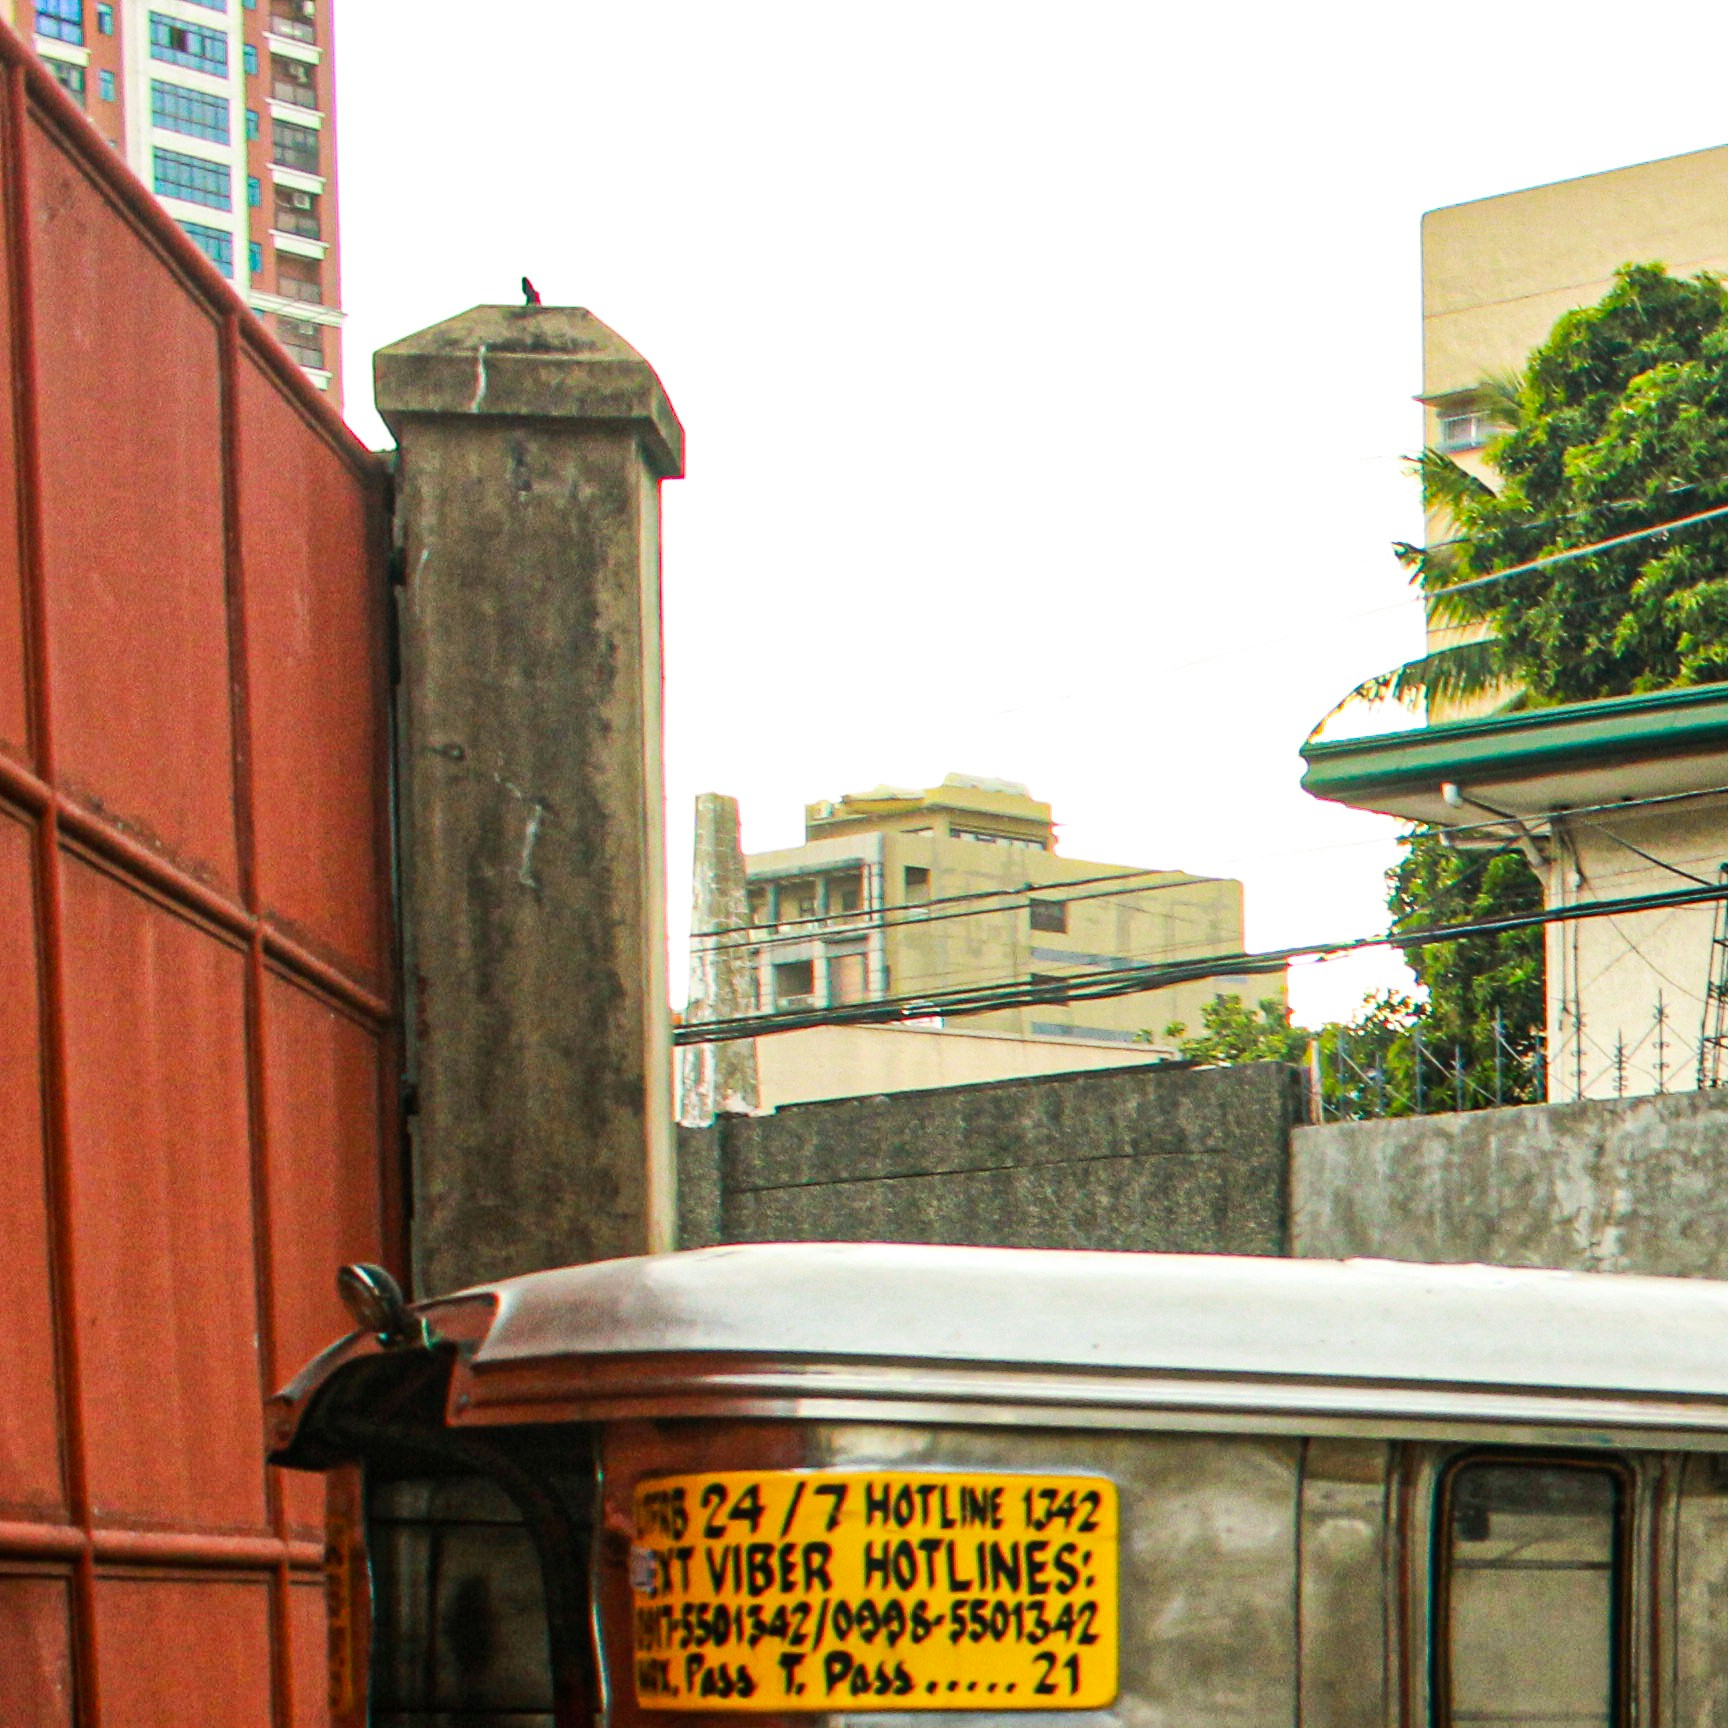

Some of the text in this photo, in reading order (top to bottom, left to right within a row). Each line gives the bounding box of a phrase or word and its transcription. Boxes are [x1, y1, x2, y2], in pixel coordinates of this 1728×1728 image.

[865, 1482, 1004, 1530] HOTLINE
[1023, 1488, 1101, 1533] 1342
[704, 1541, 833, 1598] VIBER
[864, 1538, 1095, 1596] HOTLINES:
[777, 1651, 806, 1696] T.
[1033, 1651, 1079, 1695] 21
